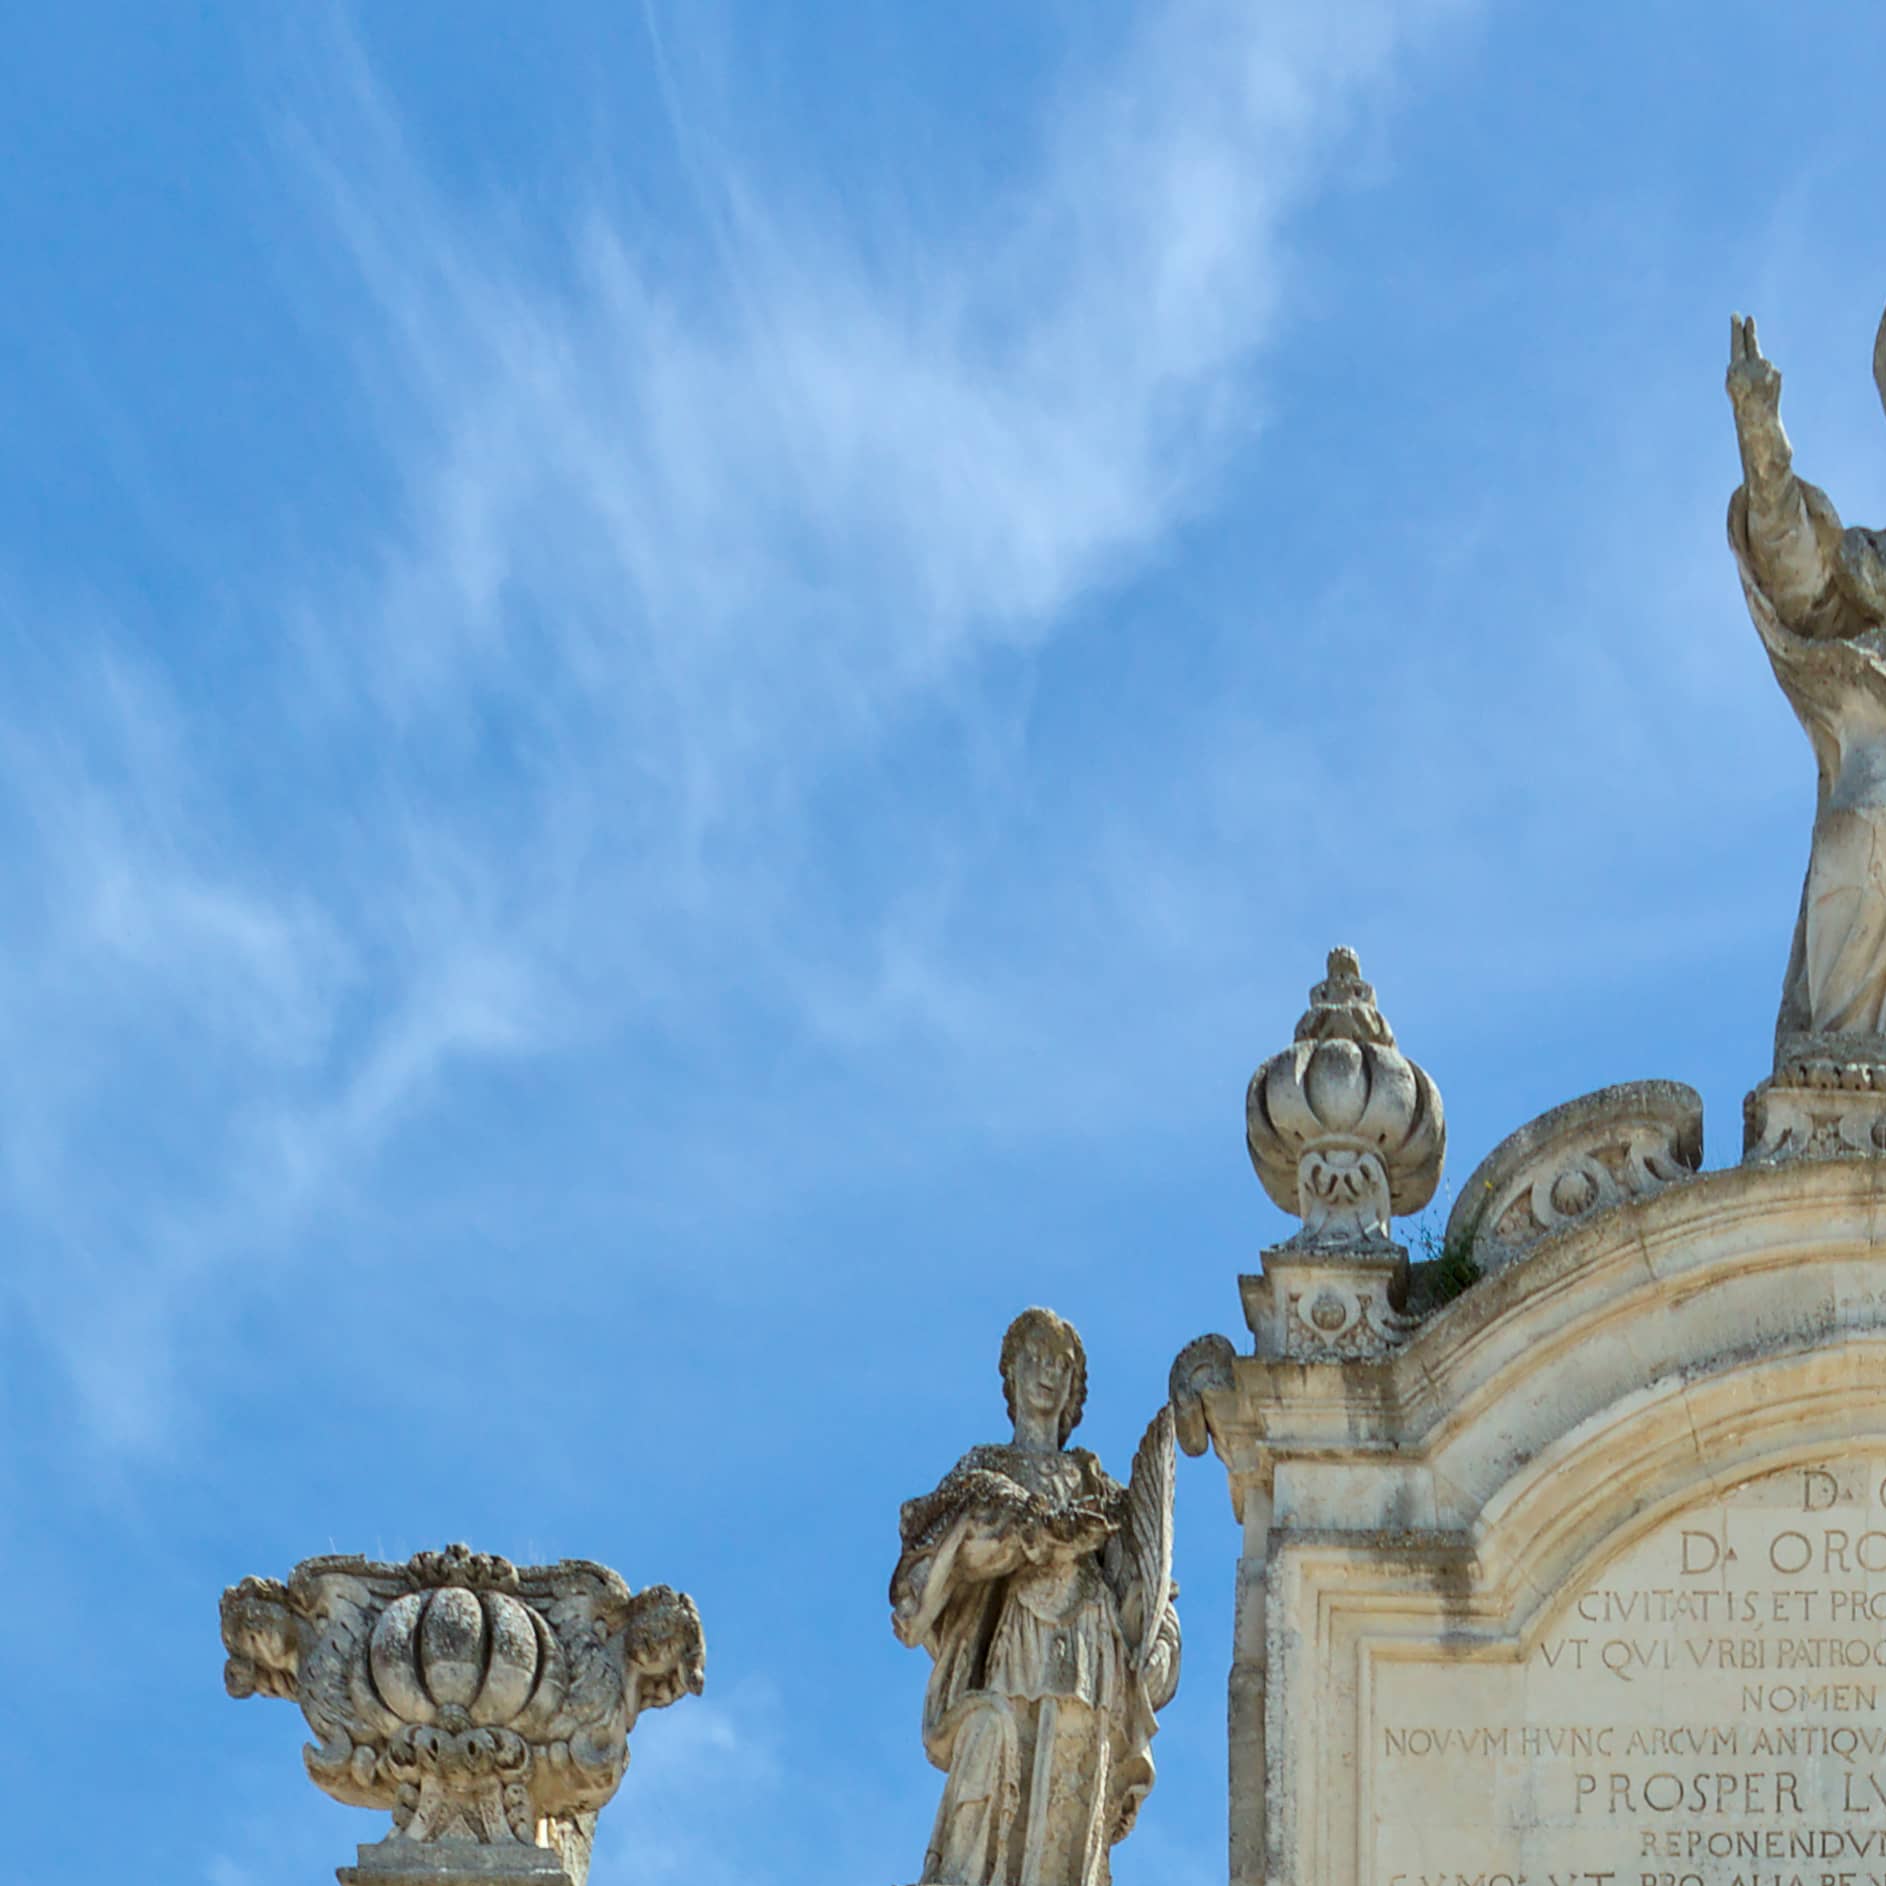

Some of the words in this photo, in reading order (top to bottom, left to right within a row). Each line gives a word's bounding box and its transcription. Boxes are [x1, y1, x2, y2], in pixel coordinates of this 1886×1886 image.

[1772, 1592, 1818, 1622] ET
[1541, 1638, 1589, 1669] VT
[1601, 1639, 1671, 1681] QVI
[1686, 1638, 1766, 1669] VRBI
[1741, 1684, 1877, 1713] NOMEN
[1521, 1727, 1615, 1757] HVNC
[1625, 1727, 1739, 1757] ARCVM
[1574, 1772, 1804, 1814] PROSPER
